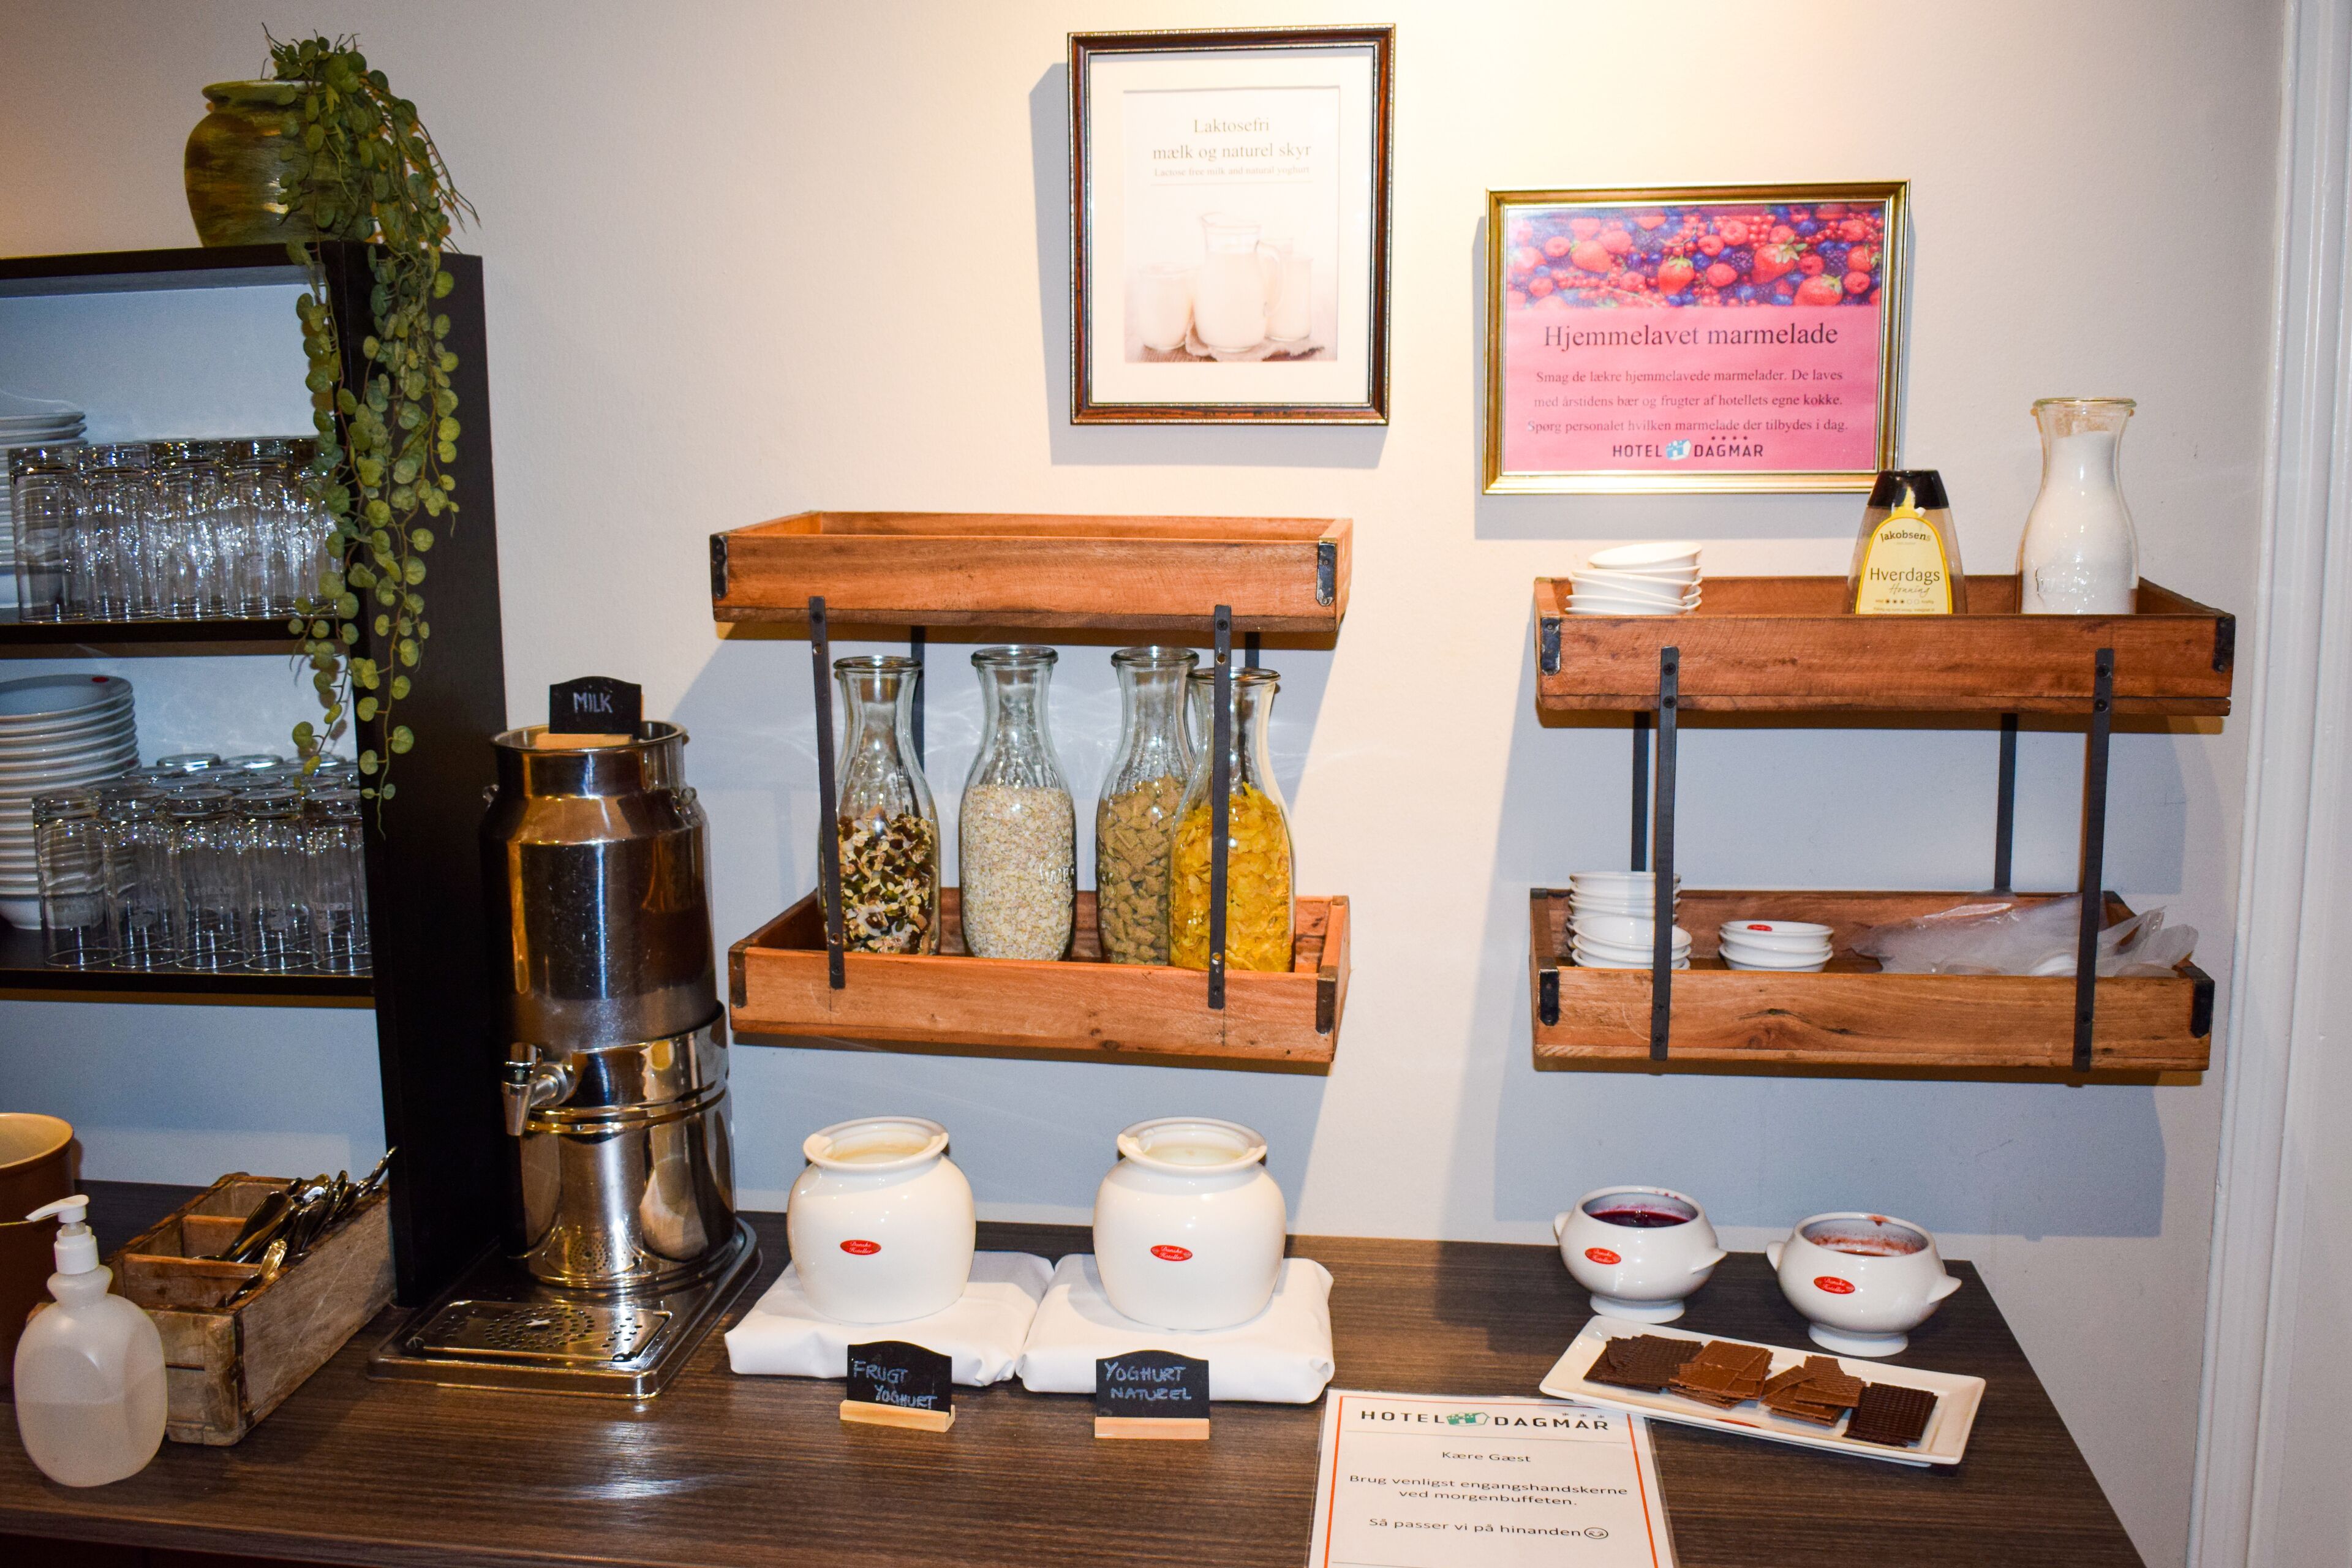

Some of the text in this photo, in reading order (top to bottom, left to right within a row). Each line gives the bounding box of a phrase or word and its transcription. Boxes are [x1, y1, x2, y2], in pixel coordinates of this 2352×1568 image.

[1194, 117, 1269, 133] Laktosefri
[1153, 142, 1311, 162] mælk og naturel skyr
[1154, 165, 1310, 177] Lactose free milk and natural yoghurt
[1544, 322, 1838, 352] Hjemmelavet marmelade
[1536, 369, 1843, 385] Smag de lækre hjemmelavede marmelader. De laves
[1534, 394, 1842, 409] med årstidens bær og frugter af hotellets egne kokke.
[1527, 419, 1848, 434] Spørg personalet hvilken marmelade der tilbydes i dag.
[1613, 443, 1764, 458] HOTEL DAGMAR
[1880, 530, 1931, 543] Jakobsens
[1870, 567, 1940, 585] Hverdags
[1889, 582, 1931, 598] Honning
[573, 692, 613, 714] MILK
[853, 1360, 908, 1384] FRUGT
[1104, 1360, 1186, 1382] YOGHURT
[874, 1384, 938, 1410] YOGHURT
[1110, 1387, 1192, 1401] NATUREL
[1361, 1410, 1609, 1431] HOTEL DAGMAR
[1442, 1450, 1531, 1463] Kære Gæst
[1349, 1475, 1628, 1496] Brug venligst engangshandskerne
[1398, 1490, 1578, 1506] ved morgenbuffeten.
[1369, 1518, 1388, 1528] Så
[1393, 1521, 1449, 1532] passer
[1474, 1523, 1494, 1534] på
[1500, 1526, 1581, 1538] hinanden
